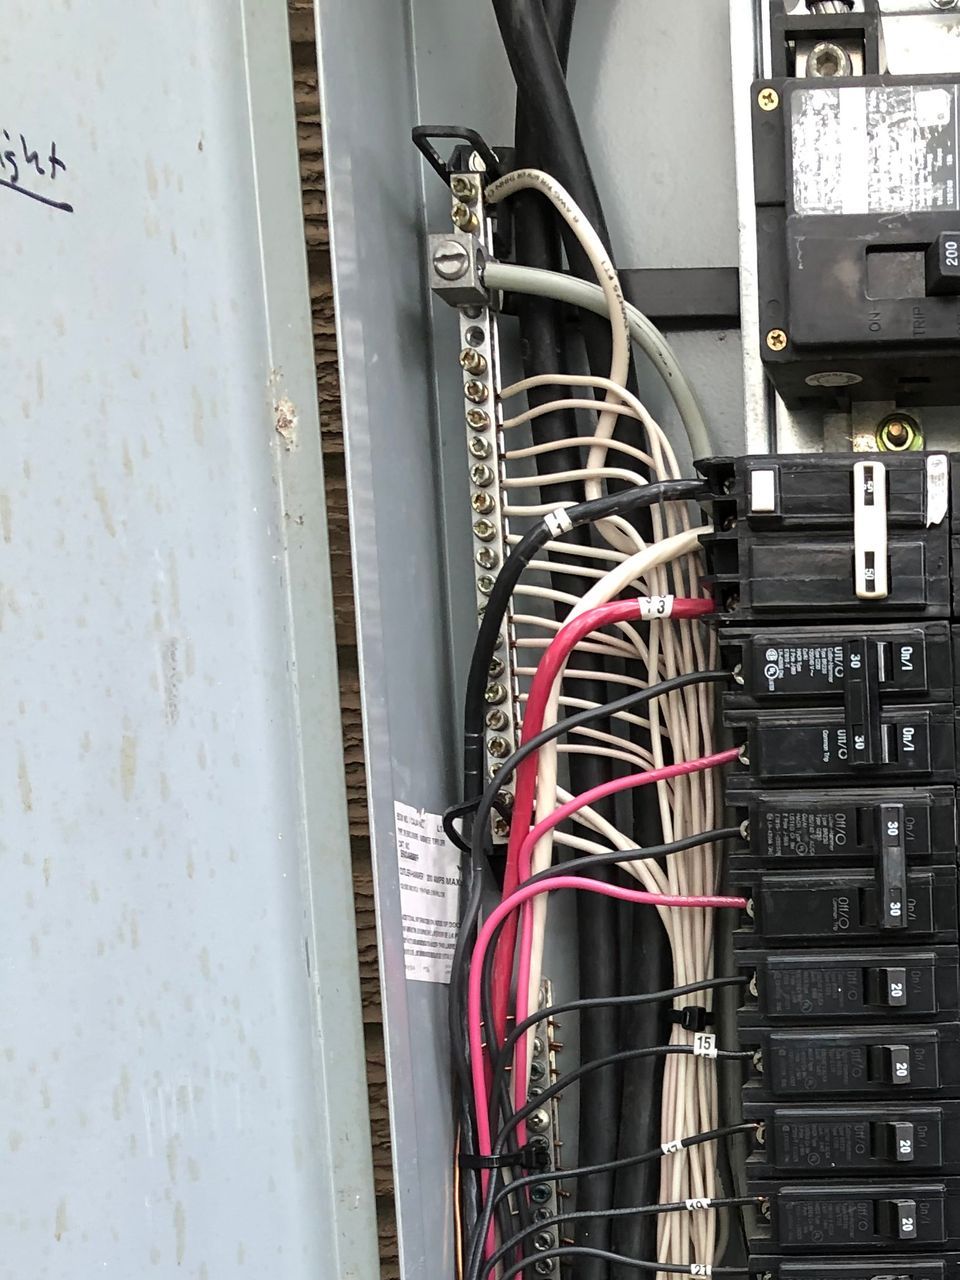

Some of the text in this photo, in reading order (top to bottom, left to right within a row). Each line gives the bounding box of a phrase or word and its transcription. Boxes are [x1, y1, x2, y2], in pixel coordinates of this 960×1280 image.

[944, 241, 959, 267] 200
[869, 311, 881, 332] ON
[913, 306, 926, 337] TRIP
[864, 568, 876, 580] 50
[655, 600, 667, 615] 3
[850, 653, 861, 669] 30
[854, 735, 865, 750] 30
[887, 821, 898, 836] 30
[890, 902, 901, 917] 30
[890, 983, 903, 998] 20
[697, 1035, 711, 1050] 15
[896, 1062, 908, 1077] 20
[900, 1139, 912, 1153] 20
[901, 1217, 913, 1232] 20
